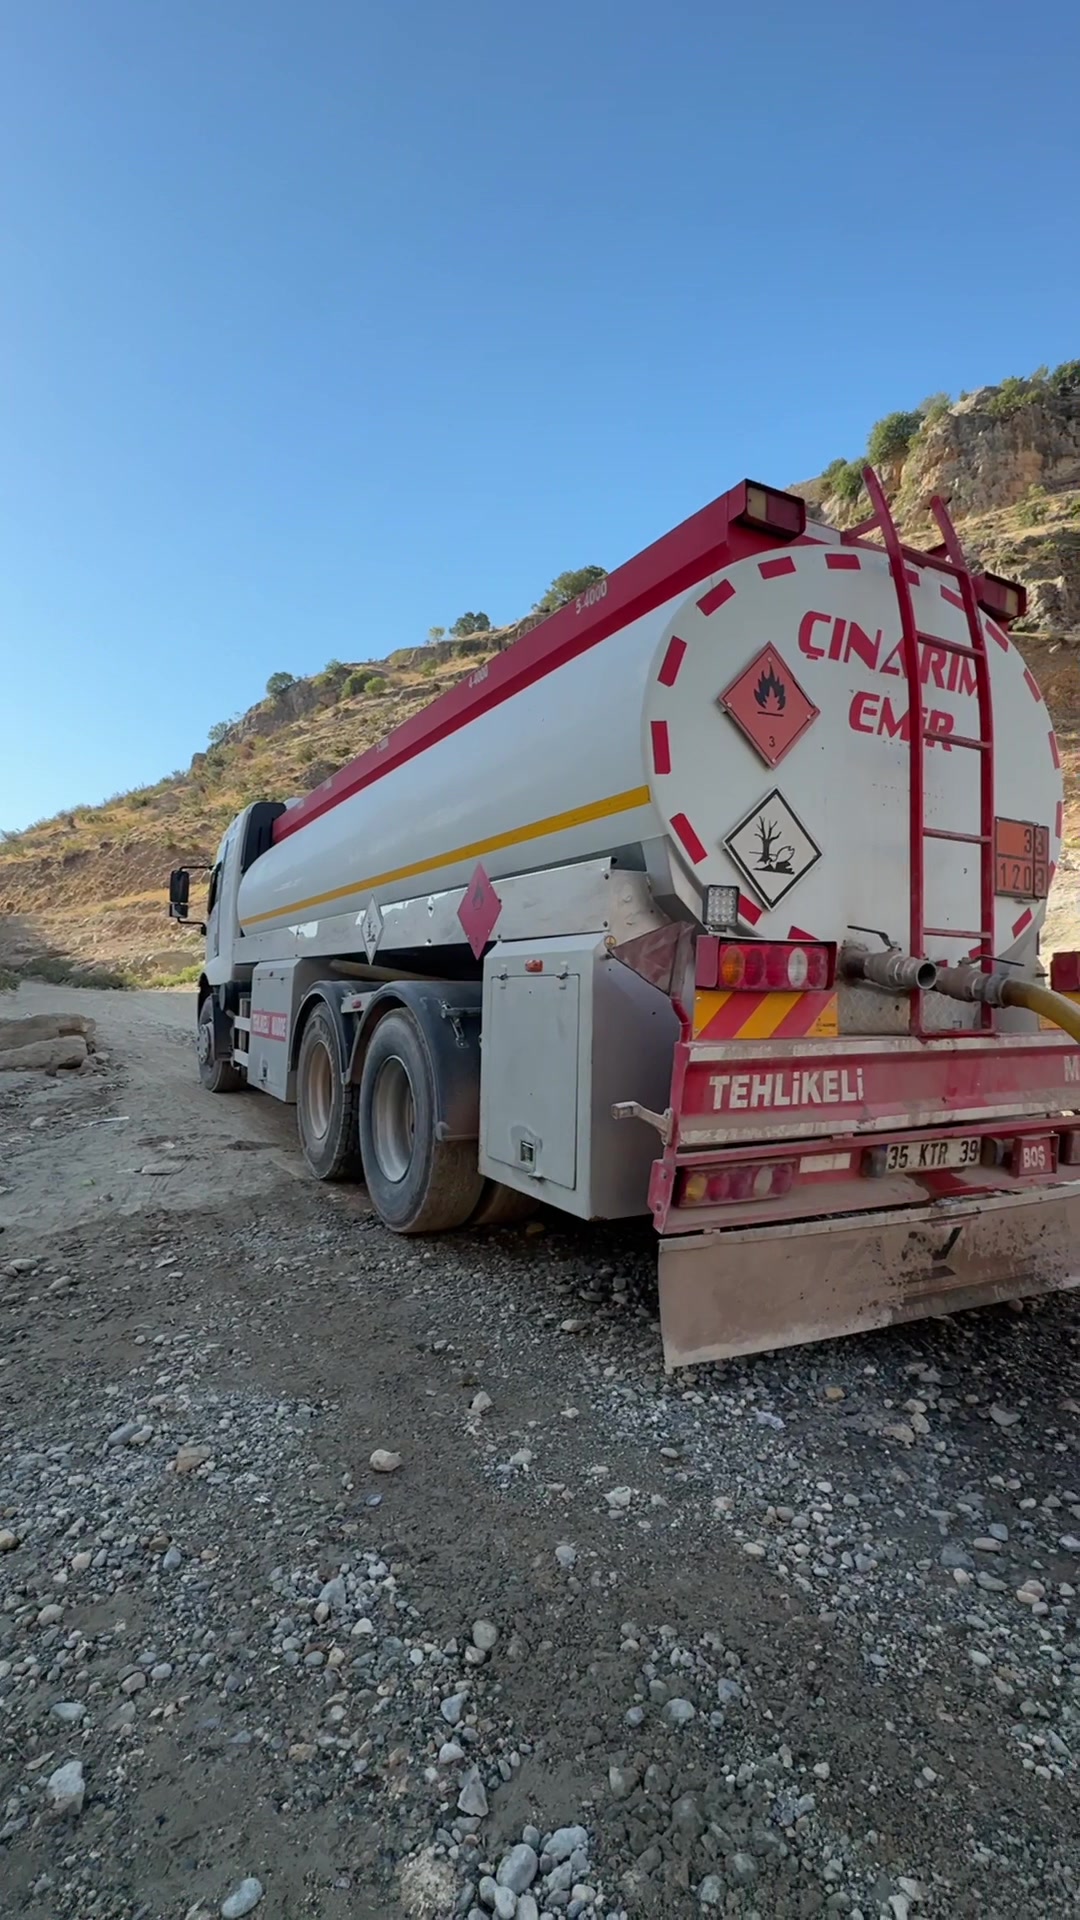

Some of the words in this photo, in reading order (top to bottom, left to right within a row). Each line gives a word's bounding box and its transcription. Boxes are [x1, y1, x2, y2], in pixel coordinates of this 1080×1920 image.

[769, 735, 776, 748] 3
[1023, 828, 1044, 856] 33
[1000, 862, 1044, 893] 1203
[888, 1145, 909, 1169] 35
[918, 1142, 948, 1167] KTR
[959, 1140, 979, 1163] 39
[1023, 1145, 1046, 1170] BOŞ
